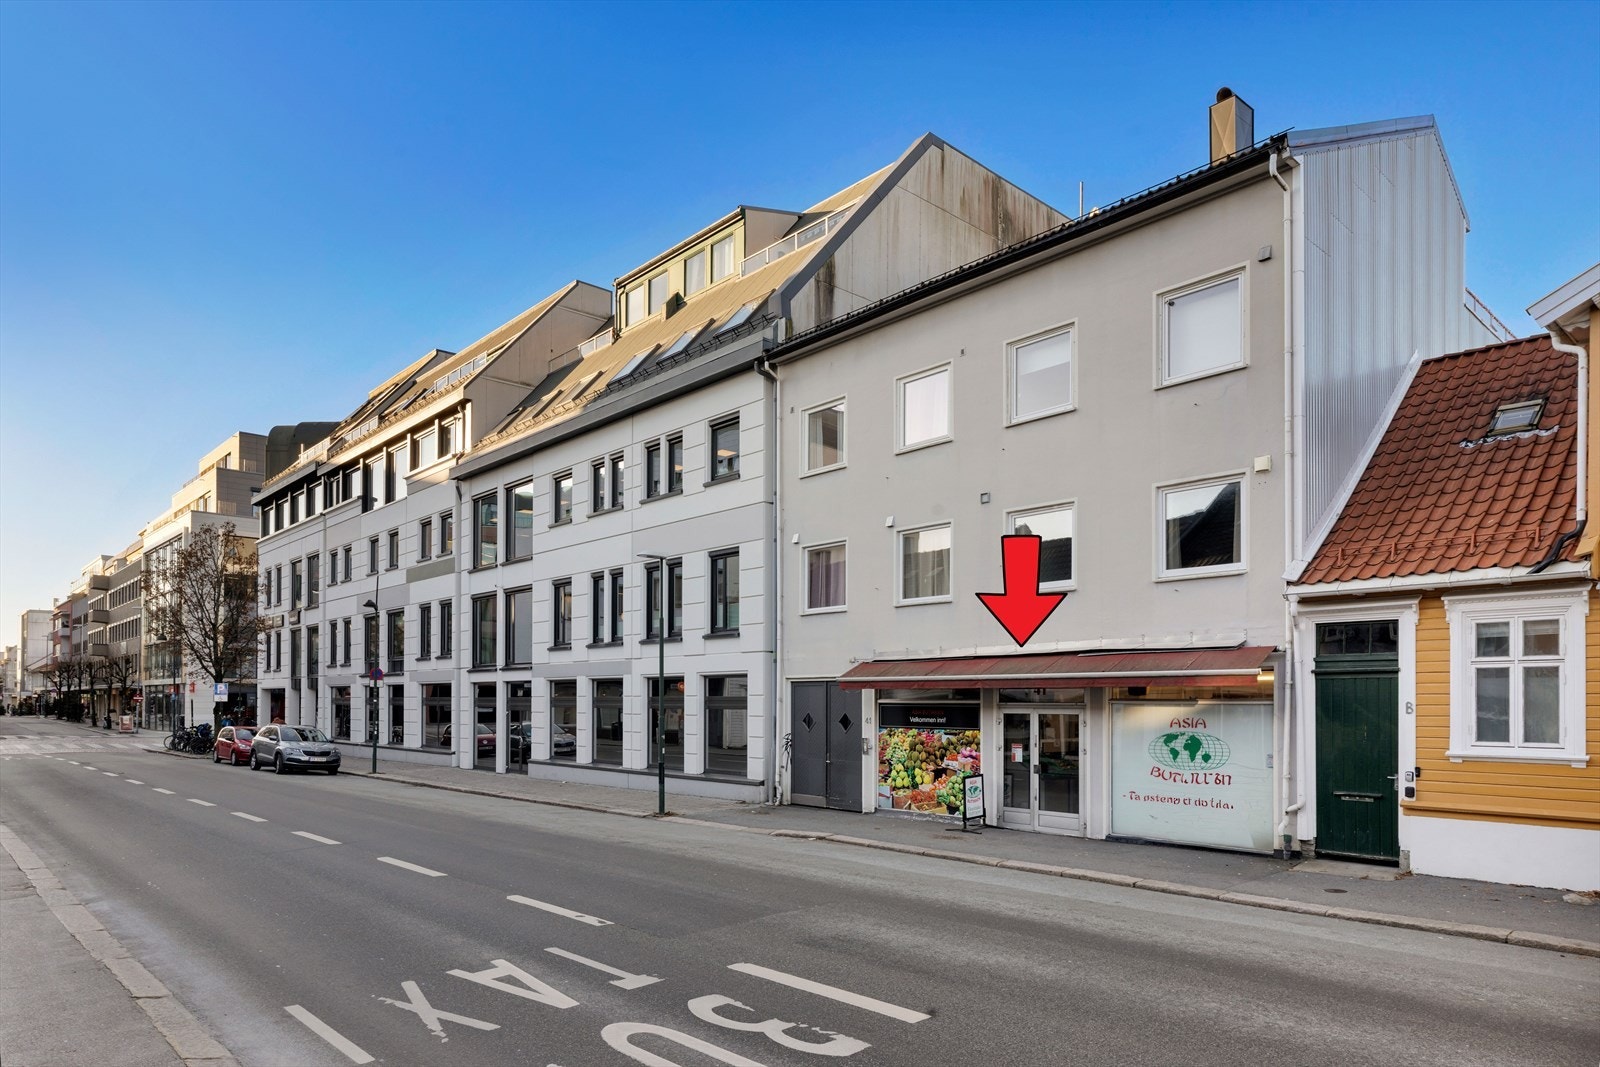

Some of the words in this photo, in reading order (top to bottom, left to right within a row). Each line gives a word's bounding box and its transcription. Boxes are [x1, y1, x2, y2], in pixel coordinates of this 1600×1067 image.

[217, 685, 225, 694] P
[1169, 717, 1207, 729] ASIA
[283, 947, 665, 1065] TAXI
